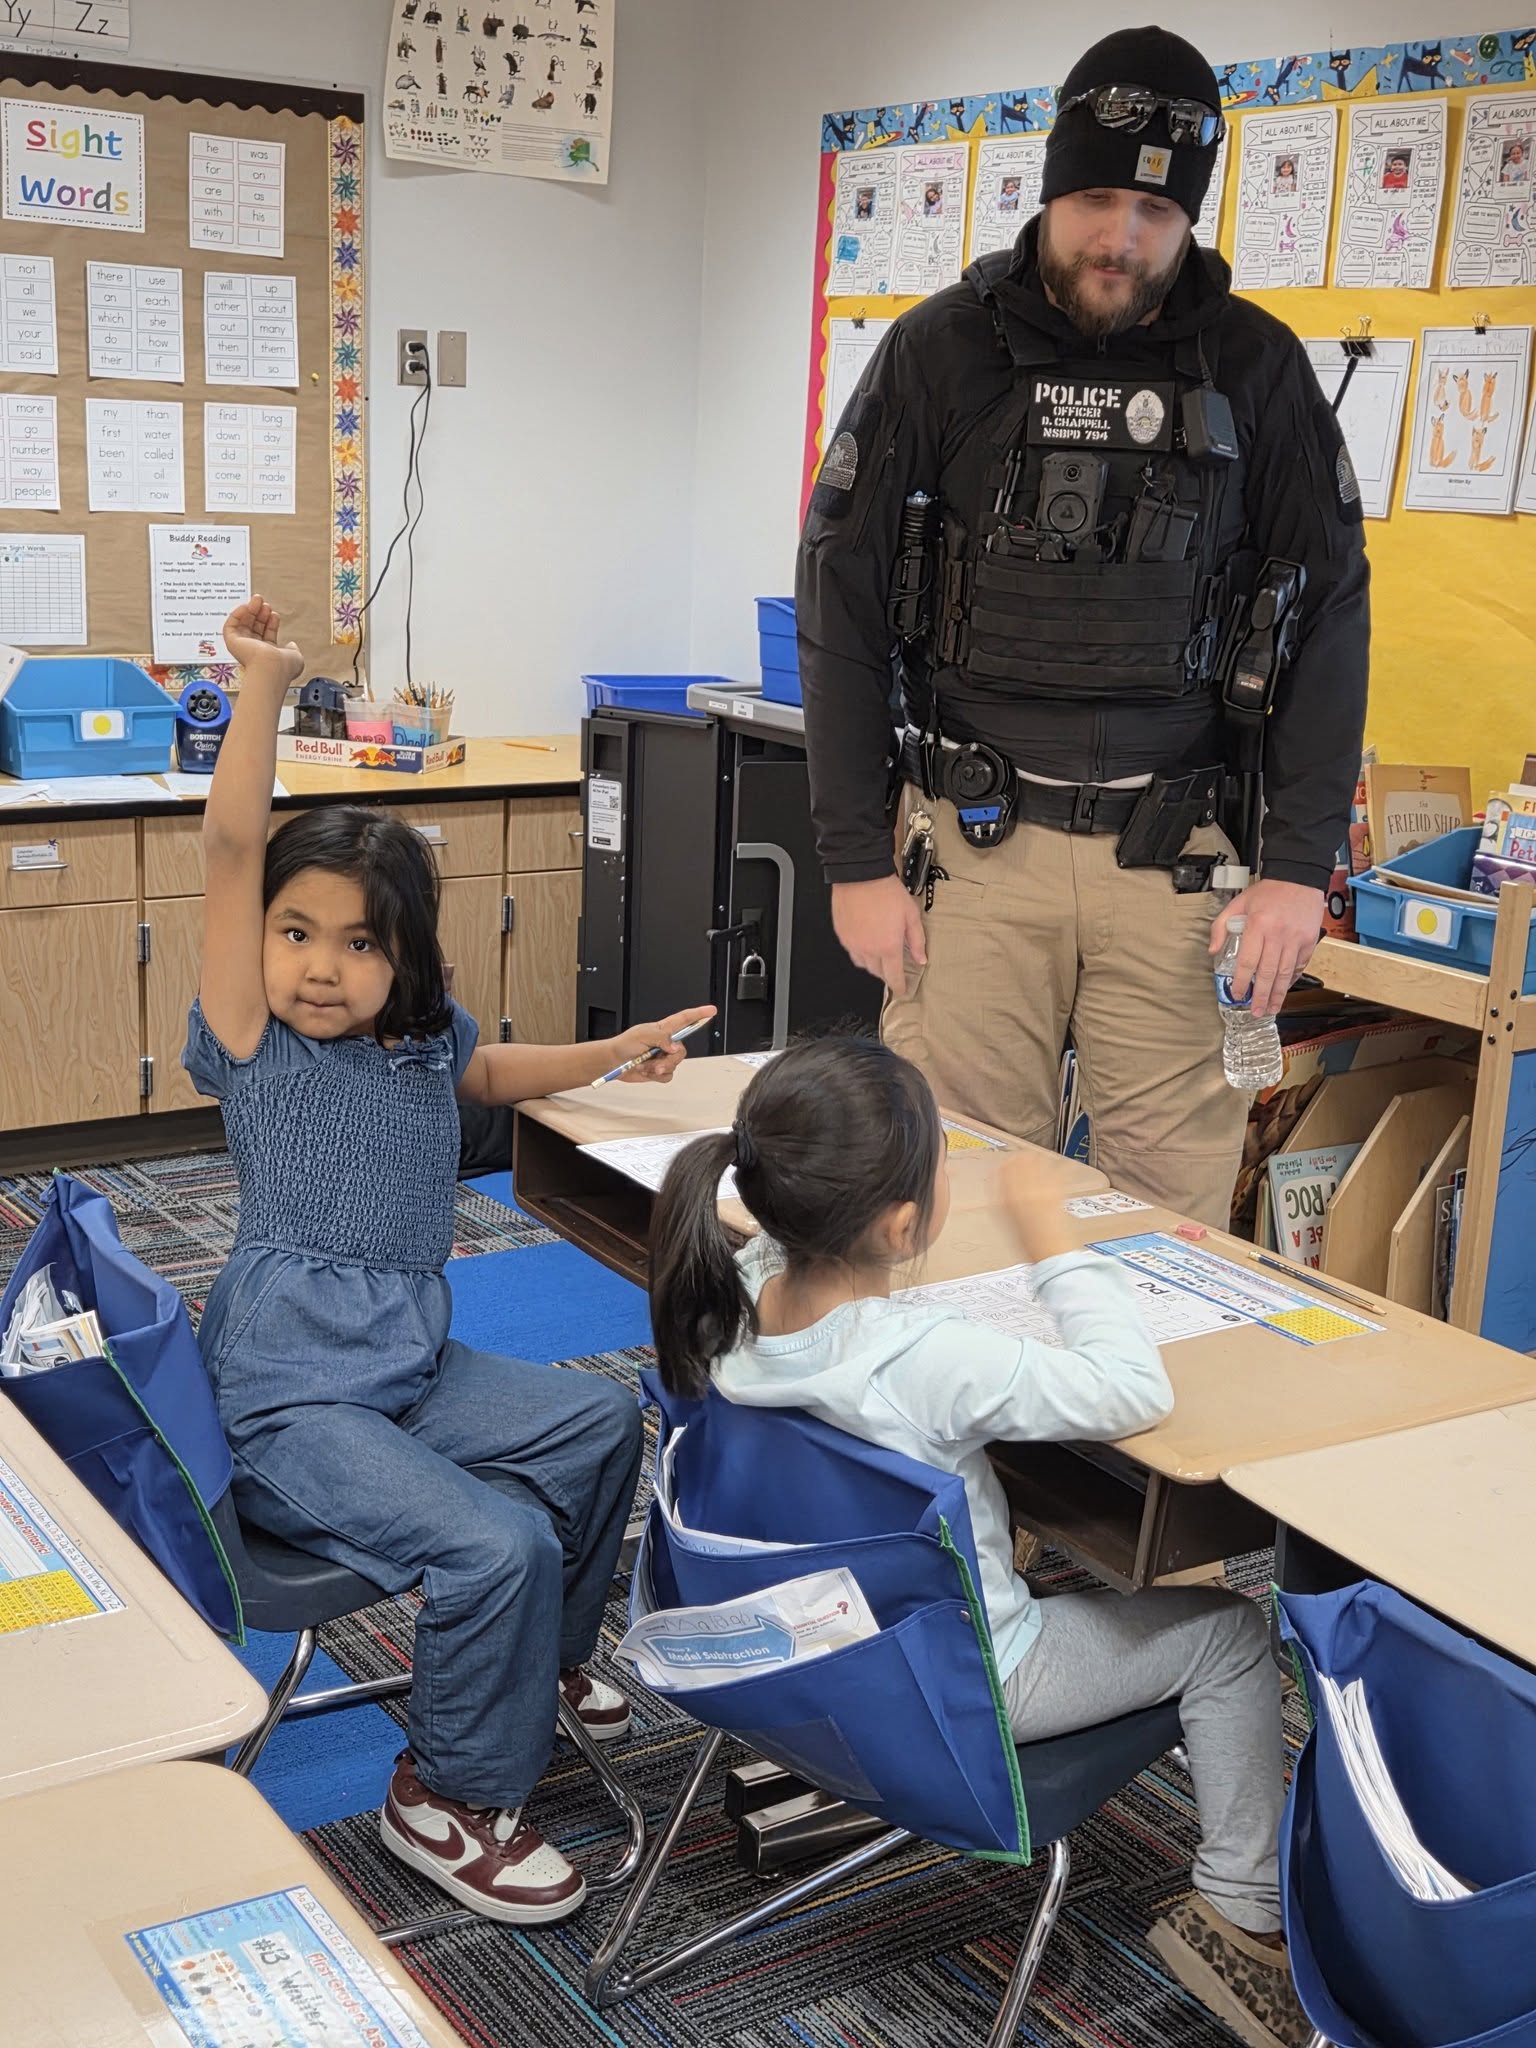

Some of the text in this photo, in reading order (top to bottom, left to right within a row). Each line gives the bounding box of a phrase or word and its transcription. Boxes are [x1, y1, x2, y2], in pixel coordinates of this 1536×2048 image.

[4, 0, 32, 38] Yy
[75, 1, 109, 35] Zz
[1492, 109, 1507, 118] ALL
[1375, 116, 1426, 128] ALL ABOUT ME
[1265, 123, 1314, 136] ALL ABOUT ME
[26, 120, 122, 158] Sight
[206, 141, 219, 153] he
[250, 151, 268, 160] was
[918, 156, 953, 165] ALL ABOUT ME
[1006, 151, 1024, 159] ABOUT
[1025, 150, 1033, 158] ME
[206, 162, 221, 174] for
[861, 162, 876, 170] ABOUT
[252, 172, 266, 180] on
[21, 175, 129, 212] Words
[204, 187, 222, 196] are
[254, 192, 264, 200] as
[204, 203, 222, 216] with
[252, 209, 265, 222] his
[202, 225, 224, 240] they
[18, 265, 36, 274] not
[97, 269, 124, 282] there
[148, 276, 166, 286] use
[220, 279, 233, 291] will
[22, 283, 35, 296] all
[265, 286, 278, 297] up
[104, 294, 116, 302] an
[145, 296, 170, 306] each
[214, 300, 240, 312] other
[258, 302, 286, 314] about
[22, 309, 36, 317] we
[98, 312, 124, 323] which
[150, 315, 166, 327] she
[220, 323, 236, 332] out
[260, 325, 286, 336] many
[18, 330, 42, 340] your
[104, 332, 118, 344] do
[148, 336, 168, 347] how
[218, 340, 239, 352] then
[20, 348, 42, 360] said
[261, 342, 286, 354] them
[154, 356, 163, 368] if
[216, 360, 242, 372] these
[268, 366, 280, 374] so
[1035, 382, 1122, 408] POLICE
[16, 404, 44, 413] more
[104, 409, 118, 420] my
[146, 408, 170, 419] than
[218, 408, 238, 420] find
[1053, 406, 1101, 418] OFFICER
[262, 410, 283, 428] long
[1042, 416, 1112, 430] D. CHAPPELL
[24, 426, 38, 439] go
[102, 426, 121, 438] first
[144, 432, 172, 440] water
[216, 428, 240, 440] down
[264, 432, 281, 444] day
[1043, 428, 1108, 441] NSBPD 794
[12, 443, 52, 454] number
[99, 446, 125, 458] been
[144, 448, 174, 460] called
[221, 448, 236, 460] did
[264, 454, 280, 466] get
[22, 468, 42, 478] way
[102, 466, 122, 478] who
[154, 468, 165, 480] oil
[215, 472, 241, 480] come
[259, 472, 286, 482] made
[14, 484, 52, 500] people
[150, 491, 170, 499] now
[218, 491, 238, 502] may
[262, 492, 282, 505] part
[169, 534, 231, 543] Buddy Reading
[295, 740, 343, 756] Red Bull
[1387, 812, 1461, 835] FRIEND SHIP
[1291, 1226, 1324, 1248] BE A
[1136, 1282, 1170, 1296] Dd
[12, 1508, 25, 1526] Are
[20, 1520, 50, 1556] Fantastic!
[668, 1646, 770, 1662] Model Subtraction
[306, 1953, 386, 2048] First Graders Are
